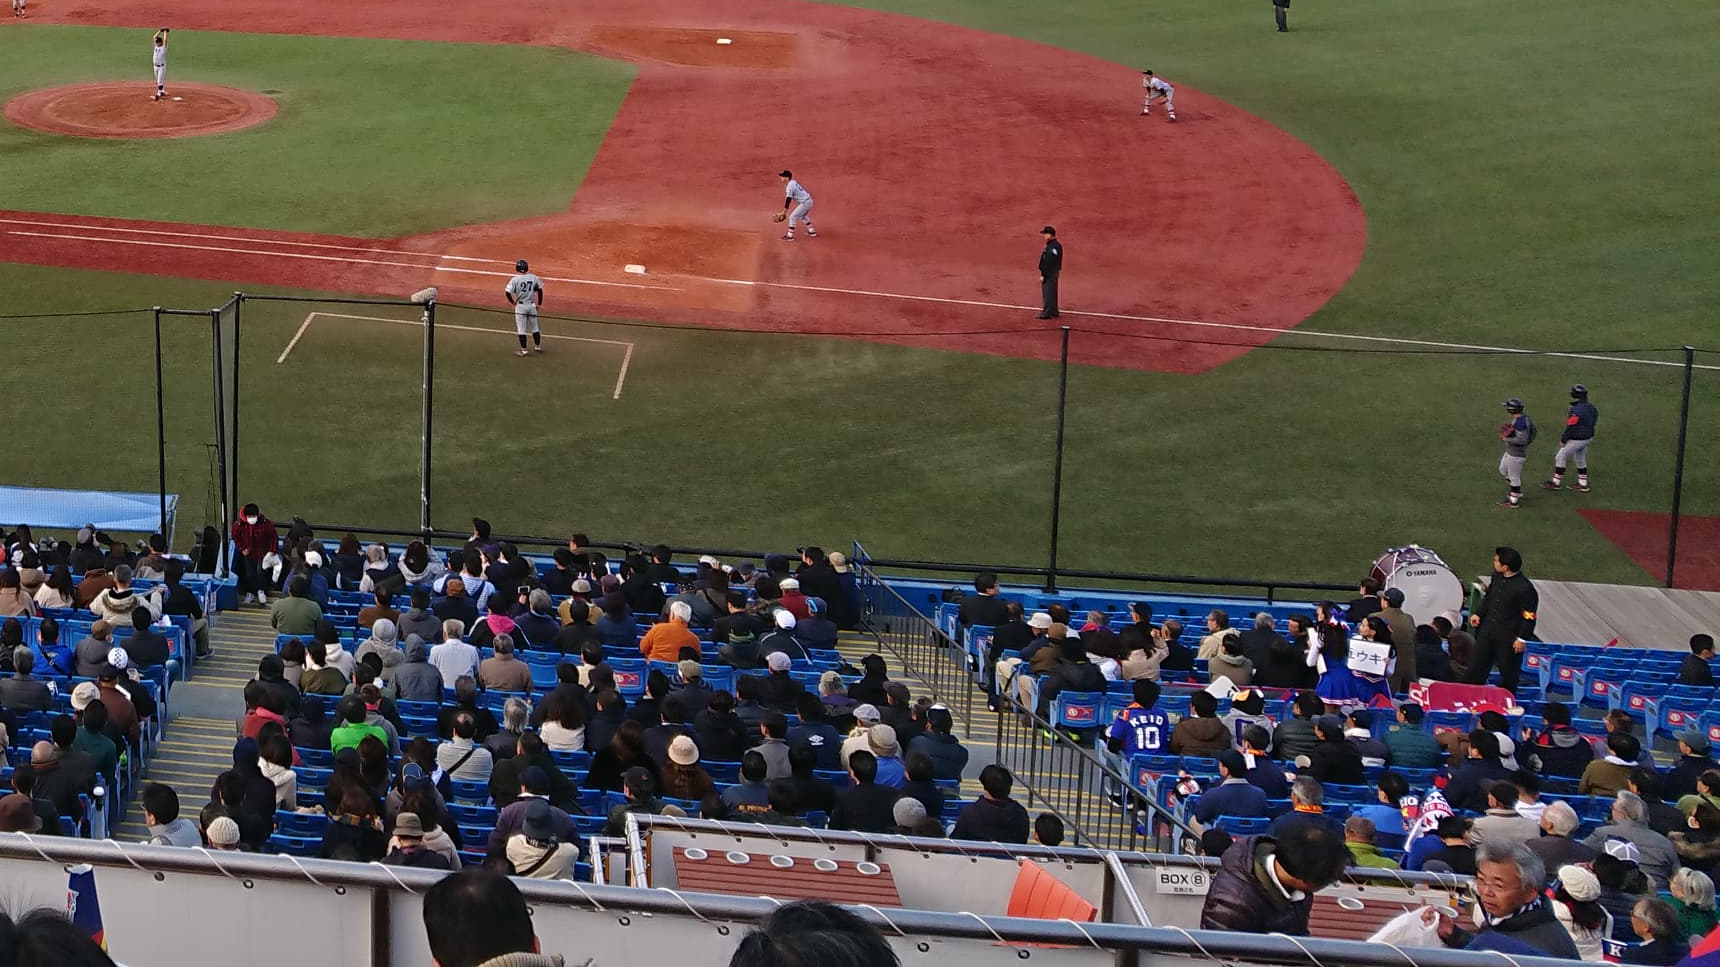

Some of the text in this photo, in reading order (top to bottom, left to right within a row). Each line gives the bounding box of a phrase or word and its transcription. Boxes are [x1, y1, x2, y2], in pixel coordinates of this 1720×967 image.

[520, 281, 533, 292] 27
[1412, 568, 1438, 578] YAMAHA
[1135, 726, 1161, 750] 10
[1160, 873, 1189, 885] BOX
